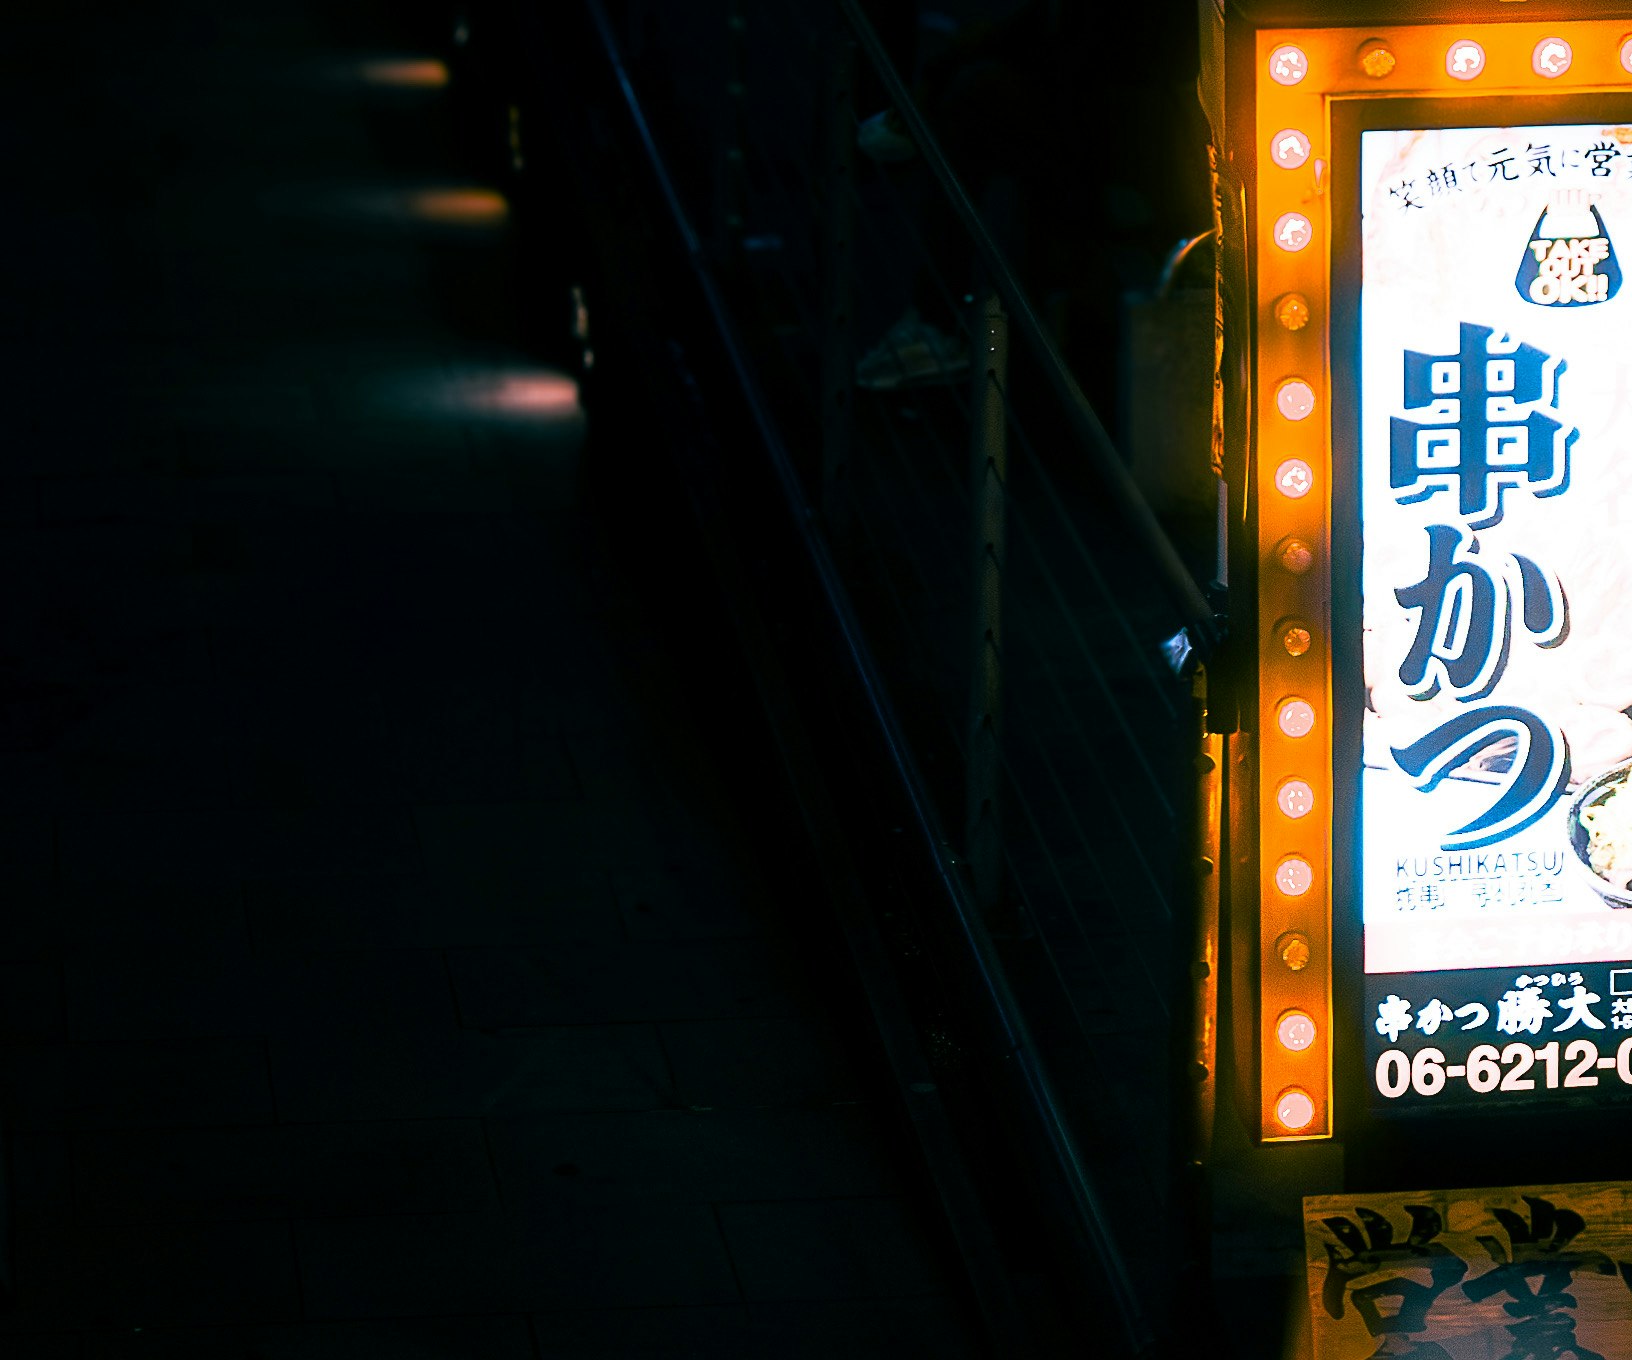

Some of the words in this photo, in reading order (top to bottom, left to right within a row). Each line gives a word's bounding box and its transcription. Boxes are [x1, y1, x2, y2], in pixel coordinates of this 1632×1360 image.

[1529, 238, 1610, 262] TAKE
[1539, 256, 1600, 278] OUT
[1529, 273, 1609, 305] OK!!
[1390, 321, 1580, 851] 串かつ
[1396, 850, 1563, 878] KUSHIKATSU
